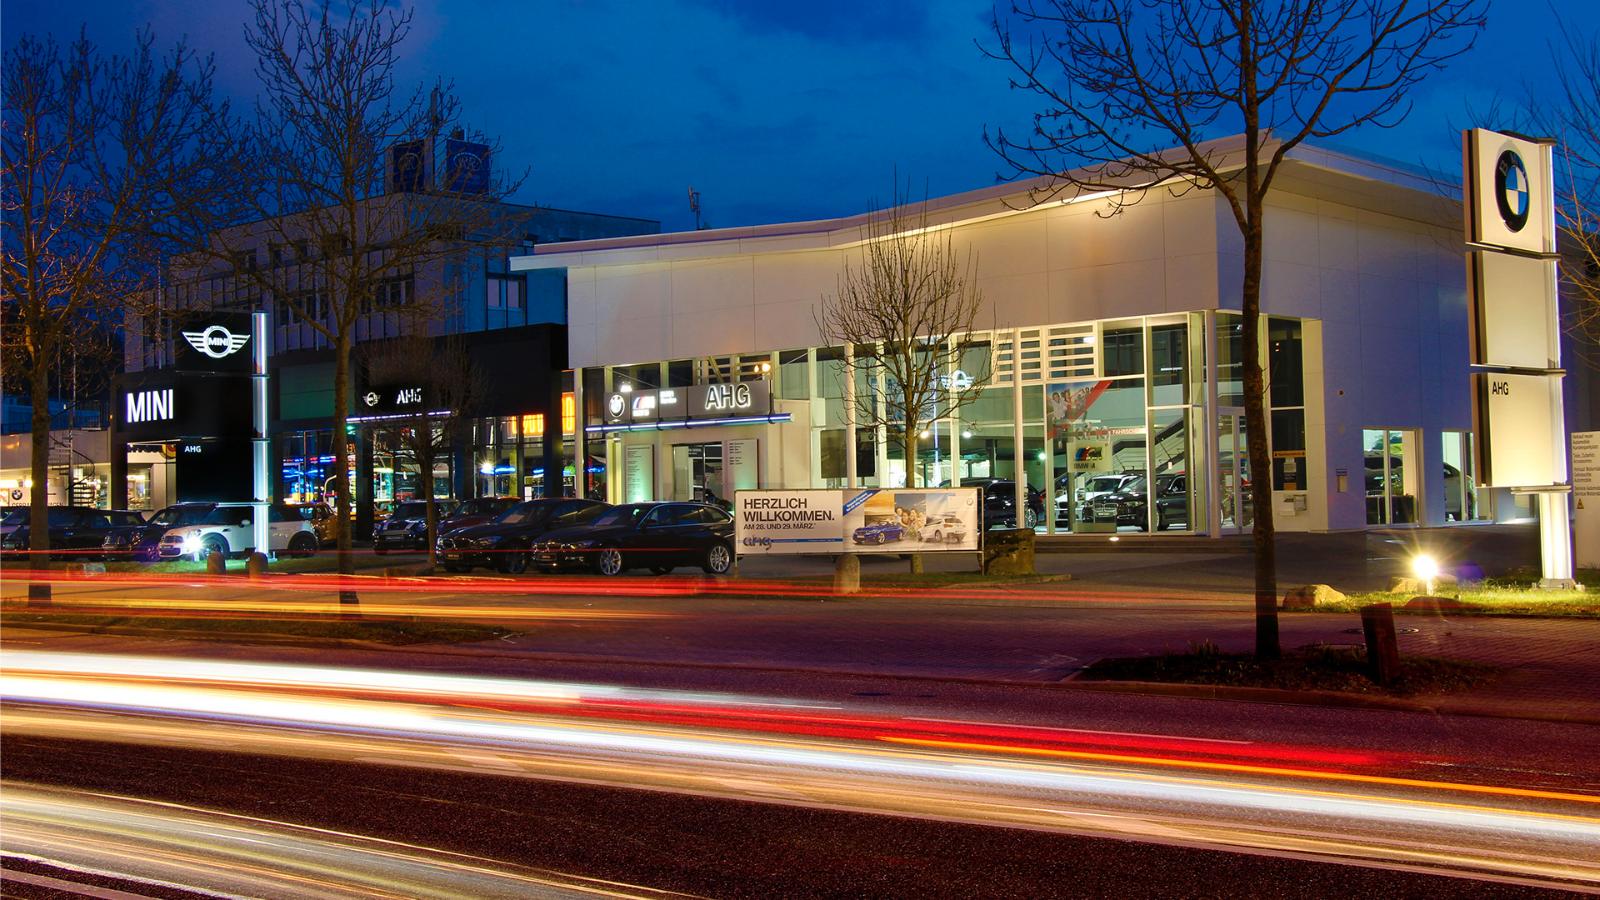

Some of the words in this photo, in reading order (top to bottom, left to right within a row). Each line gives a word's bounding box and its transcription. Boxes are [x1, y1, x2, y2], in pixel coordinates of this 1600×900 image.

[208, 337, 229, 347] MINI
[1492, 381, 1509, 395] AHG
[396, 388, 422, 405] AHG
[705, 384, 751, 409] AHG
[127, 389, 174, 423] MINI
[184, 445, 202, 453] AHG
[743, 498, 807, 509] HERZLICH
[743, 510, 835, 522] WILLKOMMEN.
